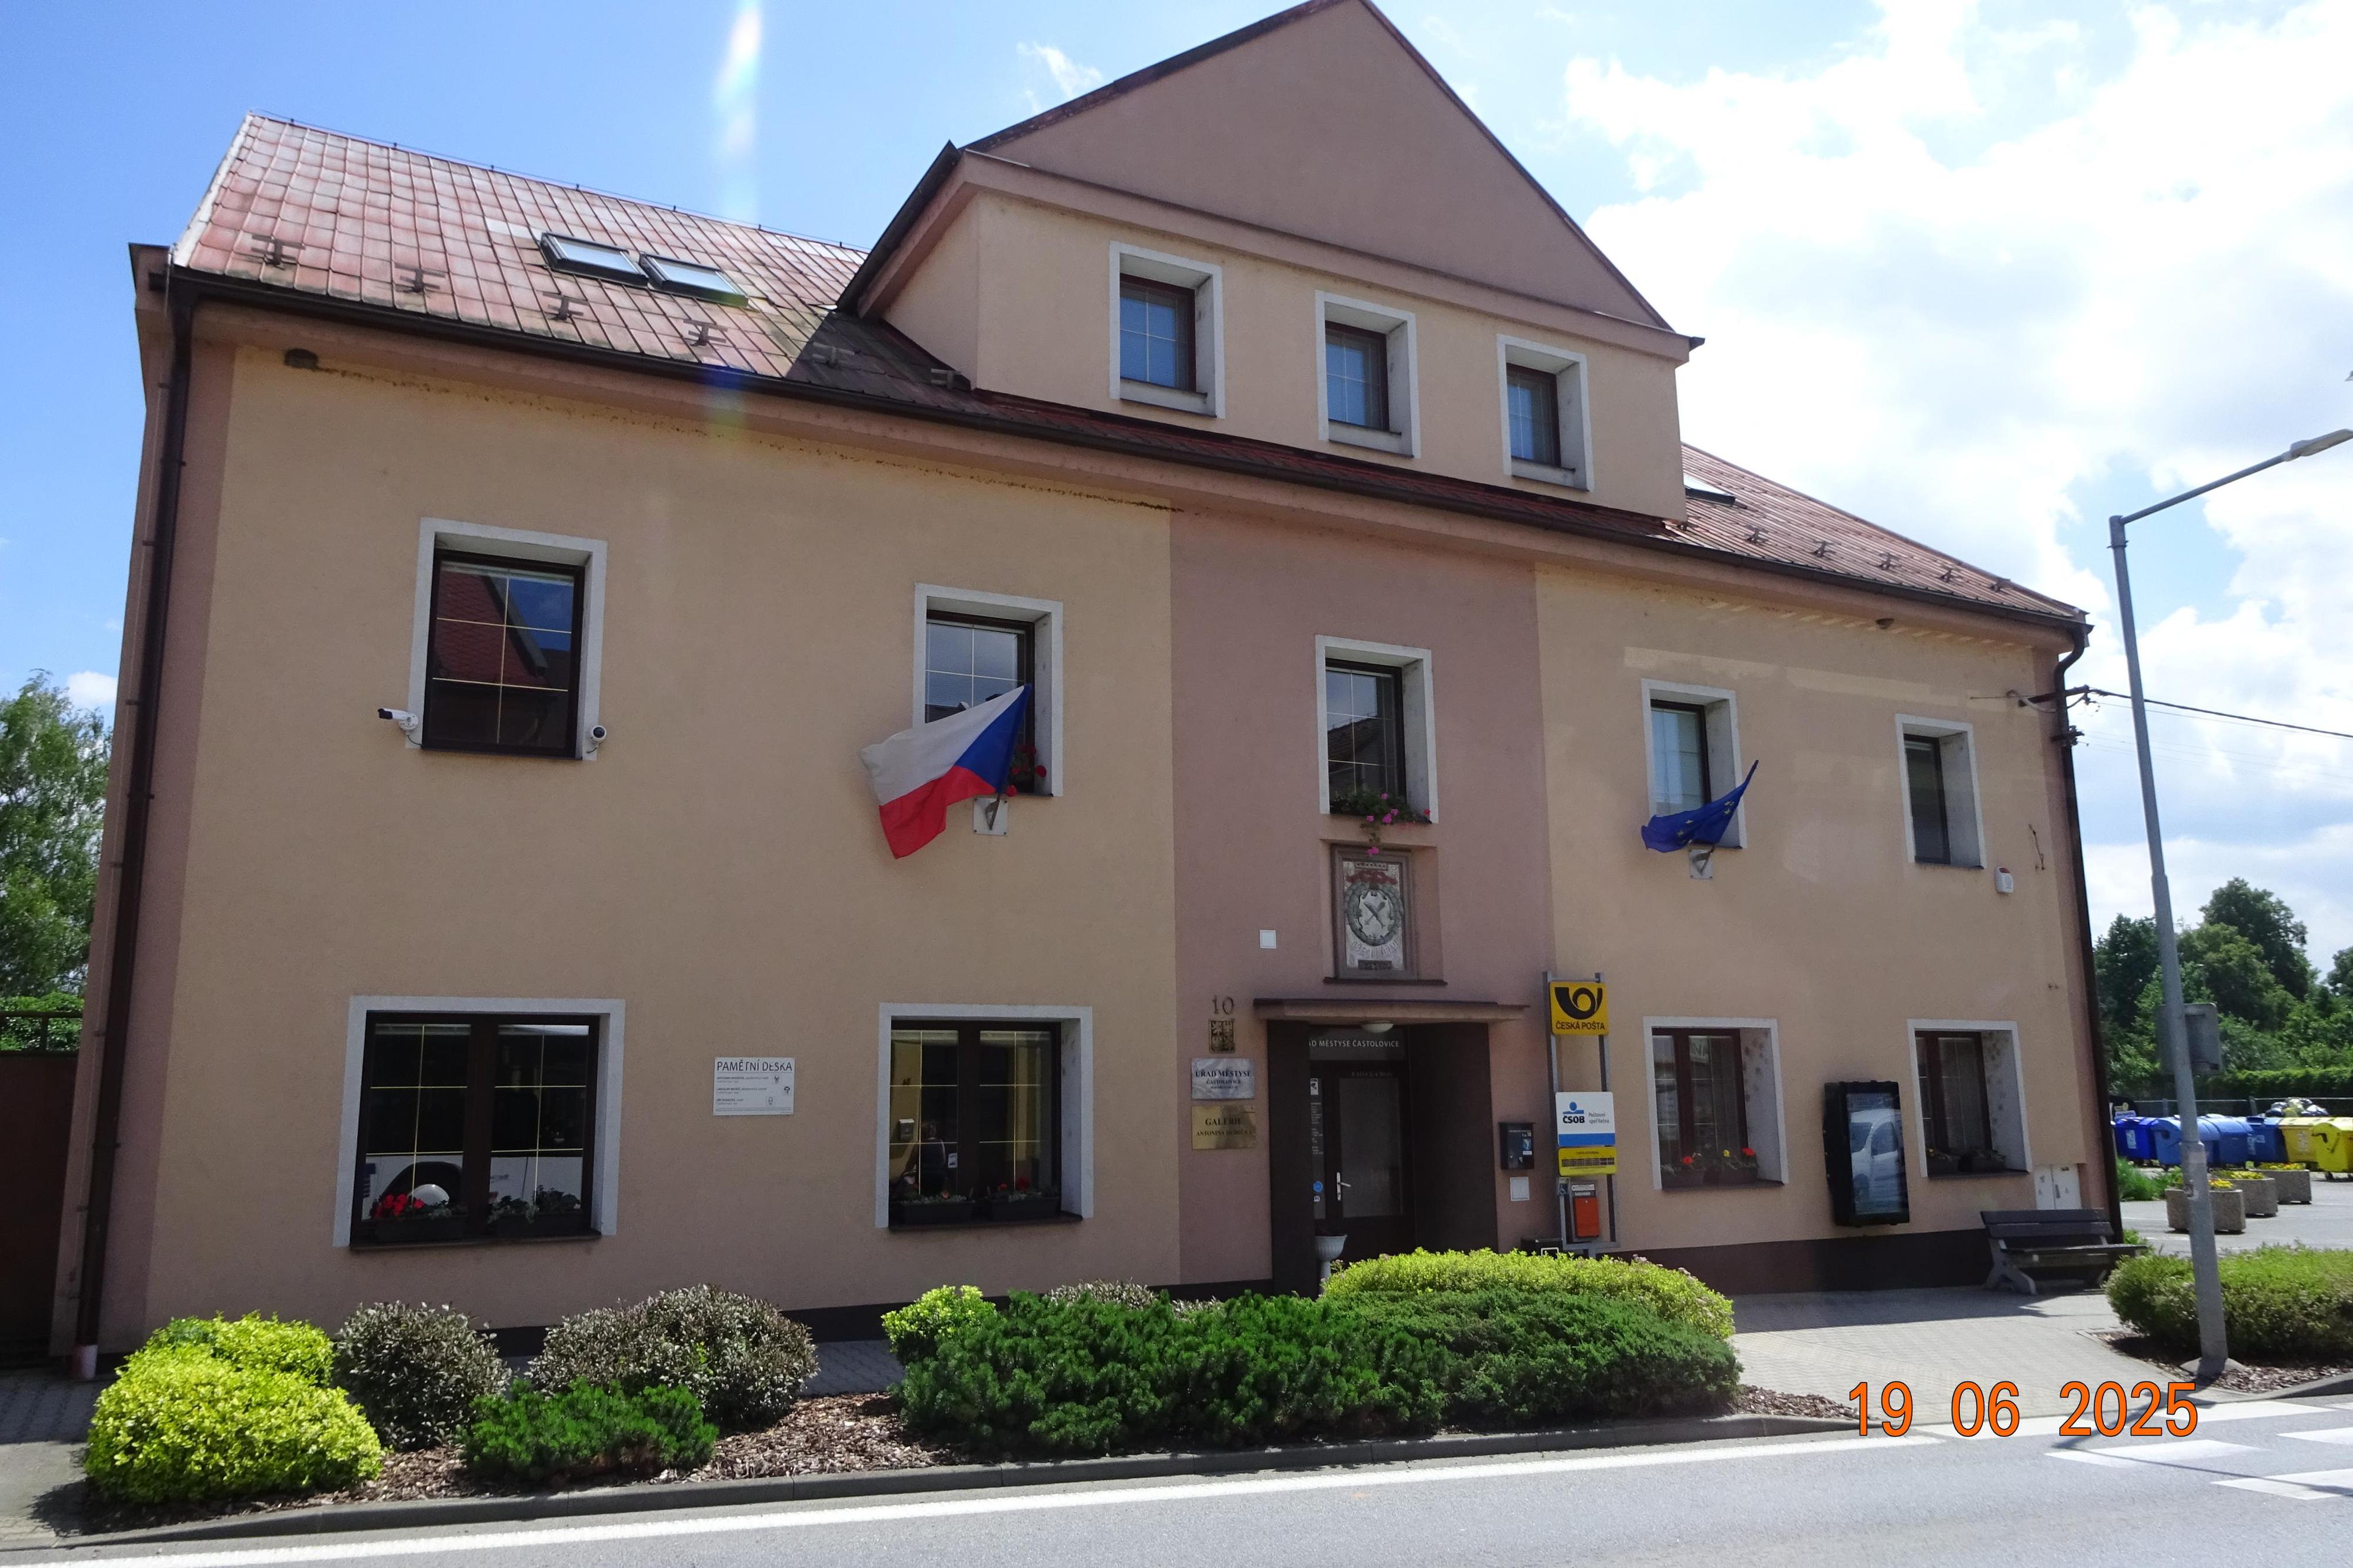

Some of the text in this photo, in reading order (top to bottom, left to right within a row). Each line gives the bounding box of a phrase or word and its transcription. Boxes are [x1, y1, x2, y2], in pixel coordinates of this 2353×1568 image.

[1212, 995, 1234, 1015] 10
[1555, 1020, 1605, 1030] ČESKÁ POŠTA
[1352, 1039, 1399, 1047] ČASTOLOVICE
[717, 1059, 792, 1071] PAMĚTNÍ DESKA
[1195, 1069, 1217, 1077] ÚŘAD
[1562, 1115, 1585, 1123] ČSOB
